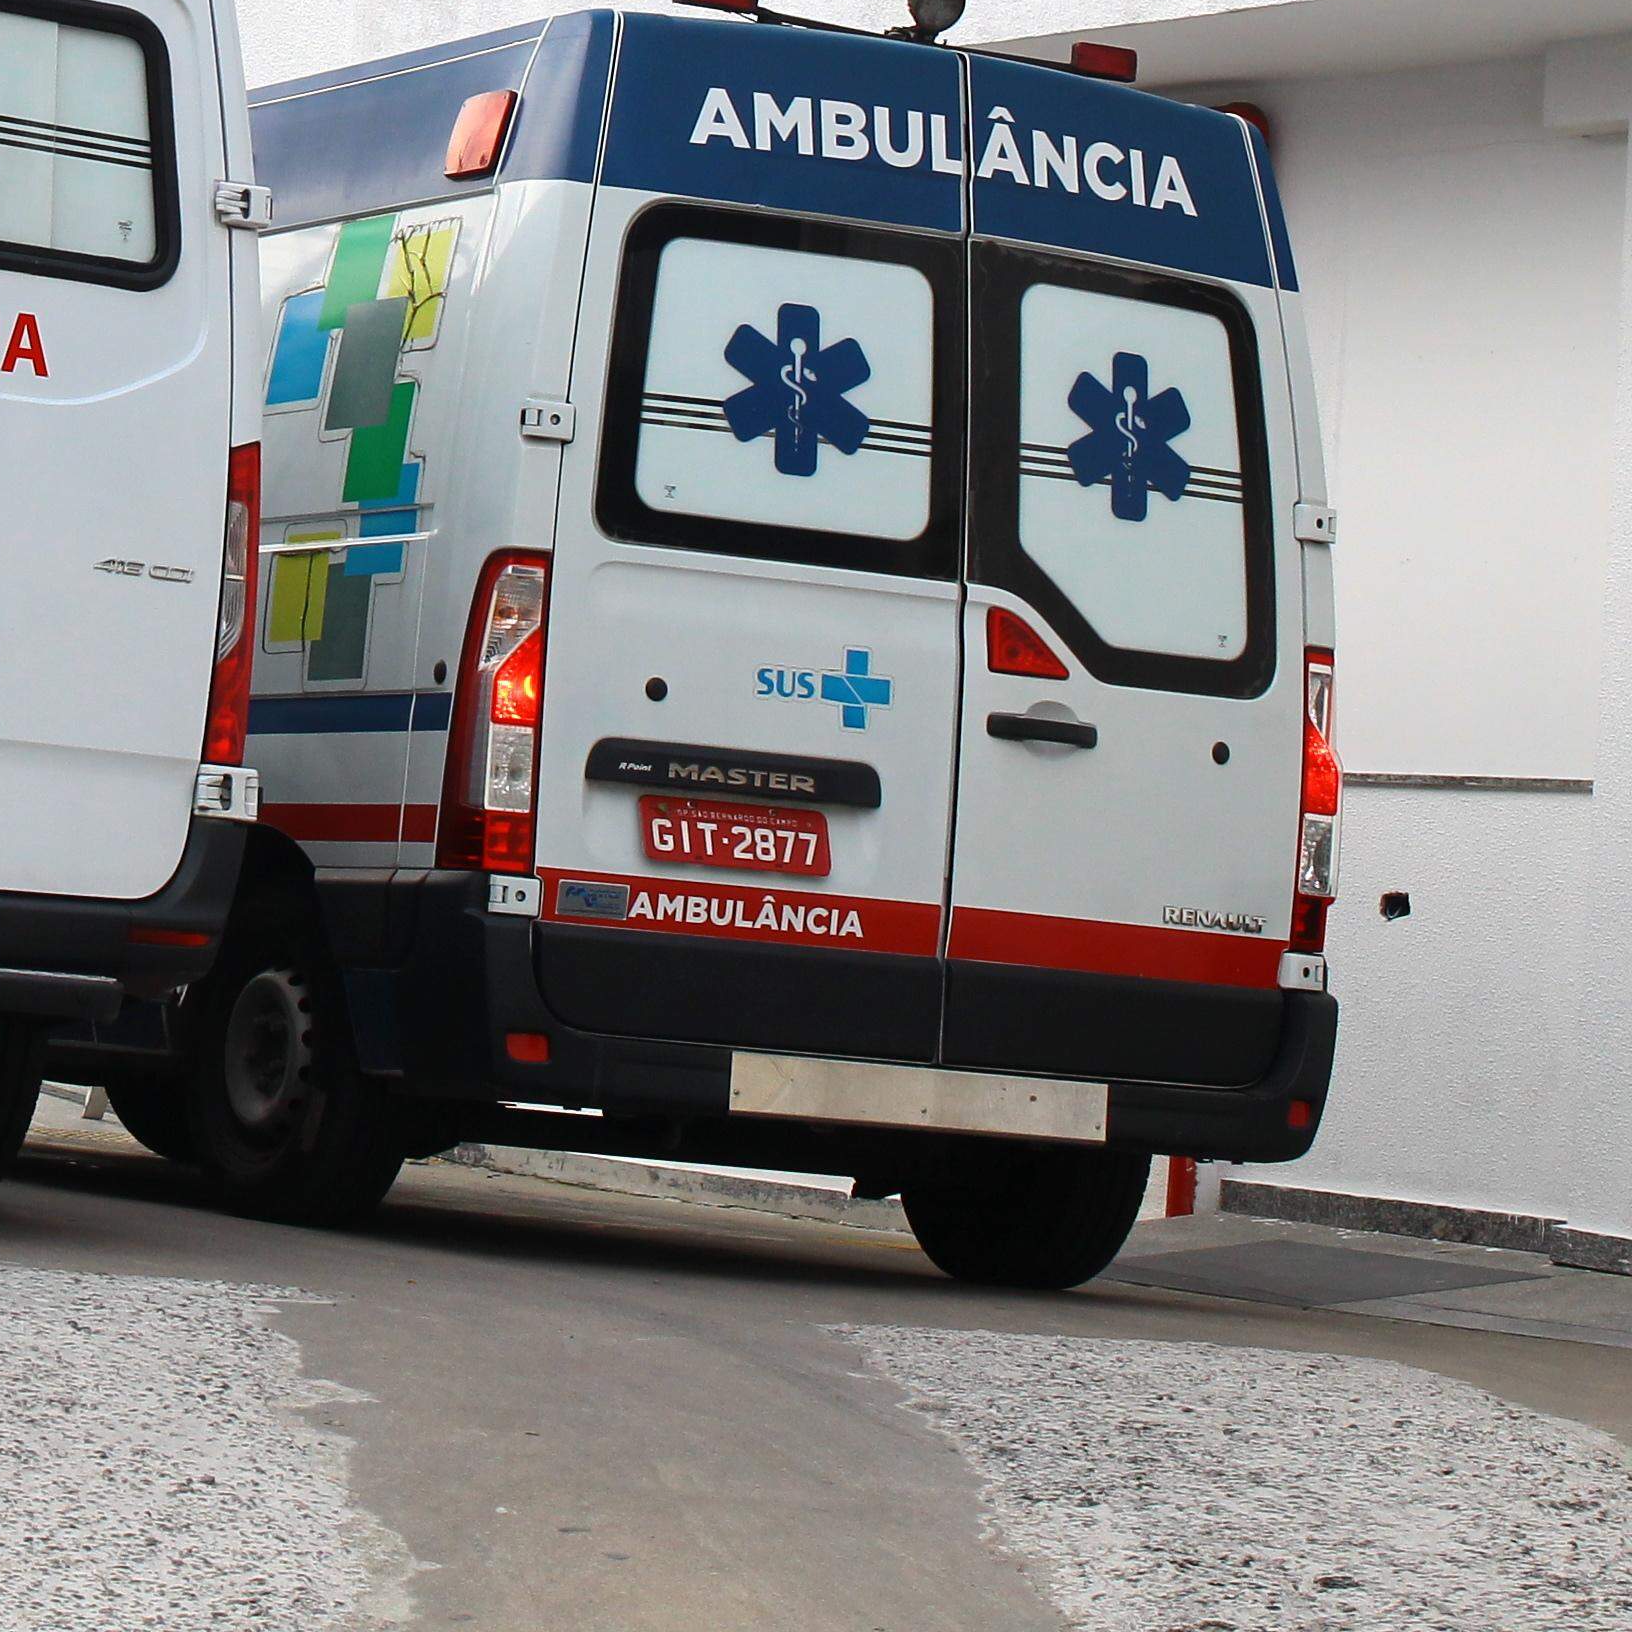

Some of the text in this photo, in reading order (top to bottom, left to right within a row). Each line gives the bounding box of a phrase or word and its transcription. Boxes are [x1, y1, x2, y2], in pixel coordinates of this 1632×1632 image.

[689, 87, 1198, 219] AMBULÂNCIA
[756, 668, 816, 699] SUS
[668, 762, 815, 793] MASTER
[627, 892, 864, 938] AMBULÂNCIA
[1163, 906, 1267, 933] RENAULT
